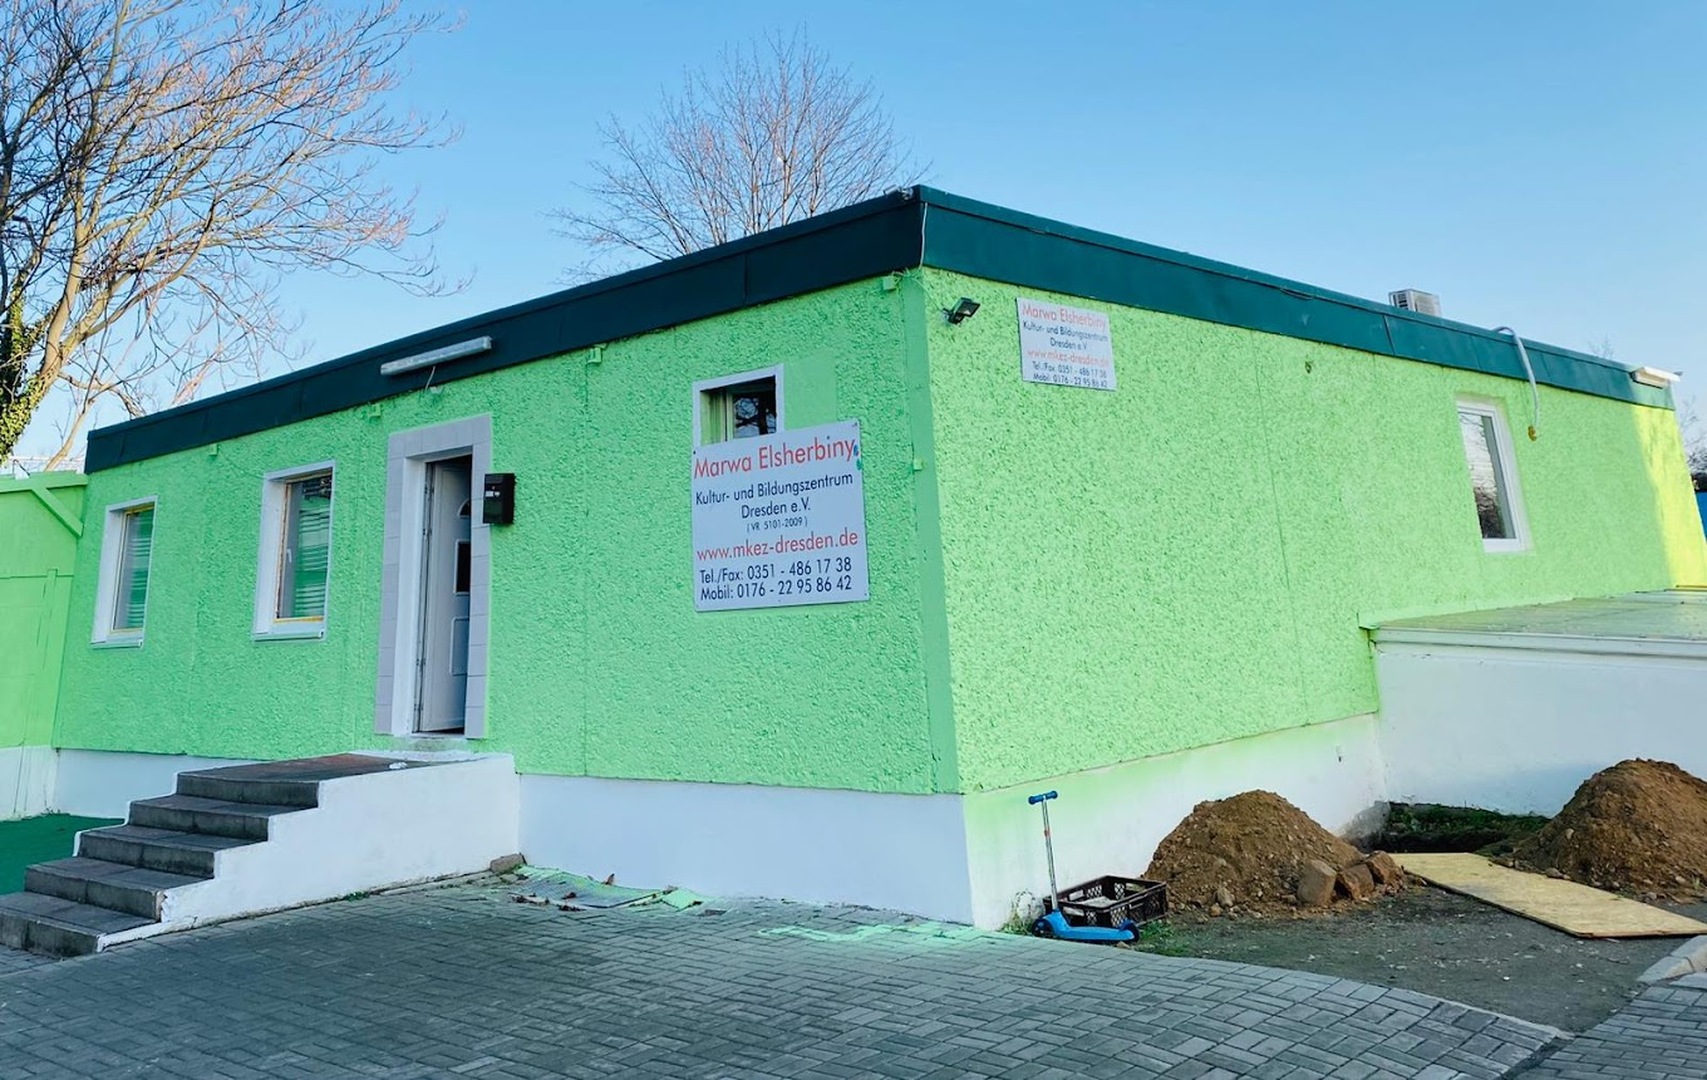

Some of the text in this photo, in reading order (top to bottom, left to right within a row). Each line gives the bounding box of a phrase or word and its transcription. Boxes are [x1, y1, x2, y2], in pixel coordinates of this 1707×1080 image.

[1022, 303, 1105, 332] Marwa Elsherbiny
[1047, 326, 1058, 334] und
[1050, 337, 1075, 348] Dresden
[694, 436, 855, 479] Marwa Elsherbiny
[696, 474, 853, 505] Kultur- und Bildungszentrum
[742, 497, 810, 518] Dresden e.V.
[697, 527, 858, 560] www.mkez-dresden.de
[747, 564, 775, 579] 0351
[789, 560, 811, 576] 486
[817, 559, 830, 573] 17
[836, 557, 851, 572] 38
[701, 587, 733, 600] Mobil:
[737, 582, 765, 598] 0176
[779, 581, 792, 595] 22
[797, 578, 811, 594] 95
[816, 577, 832, 592] 86
[837, 575, 851, 590] 42
